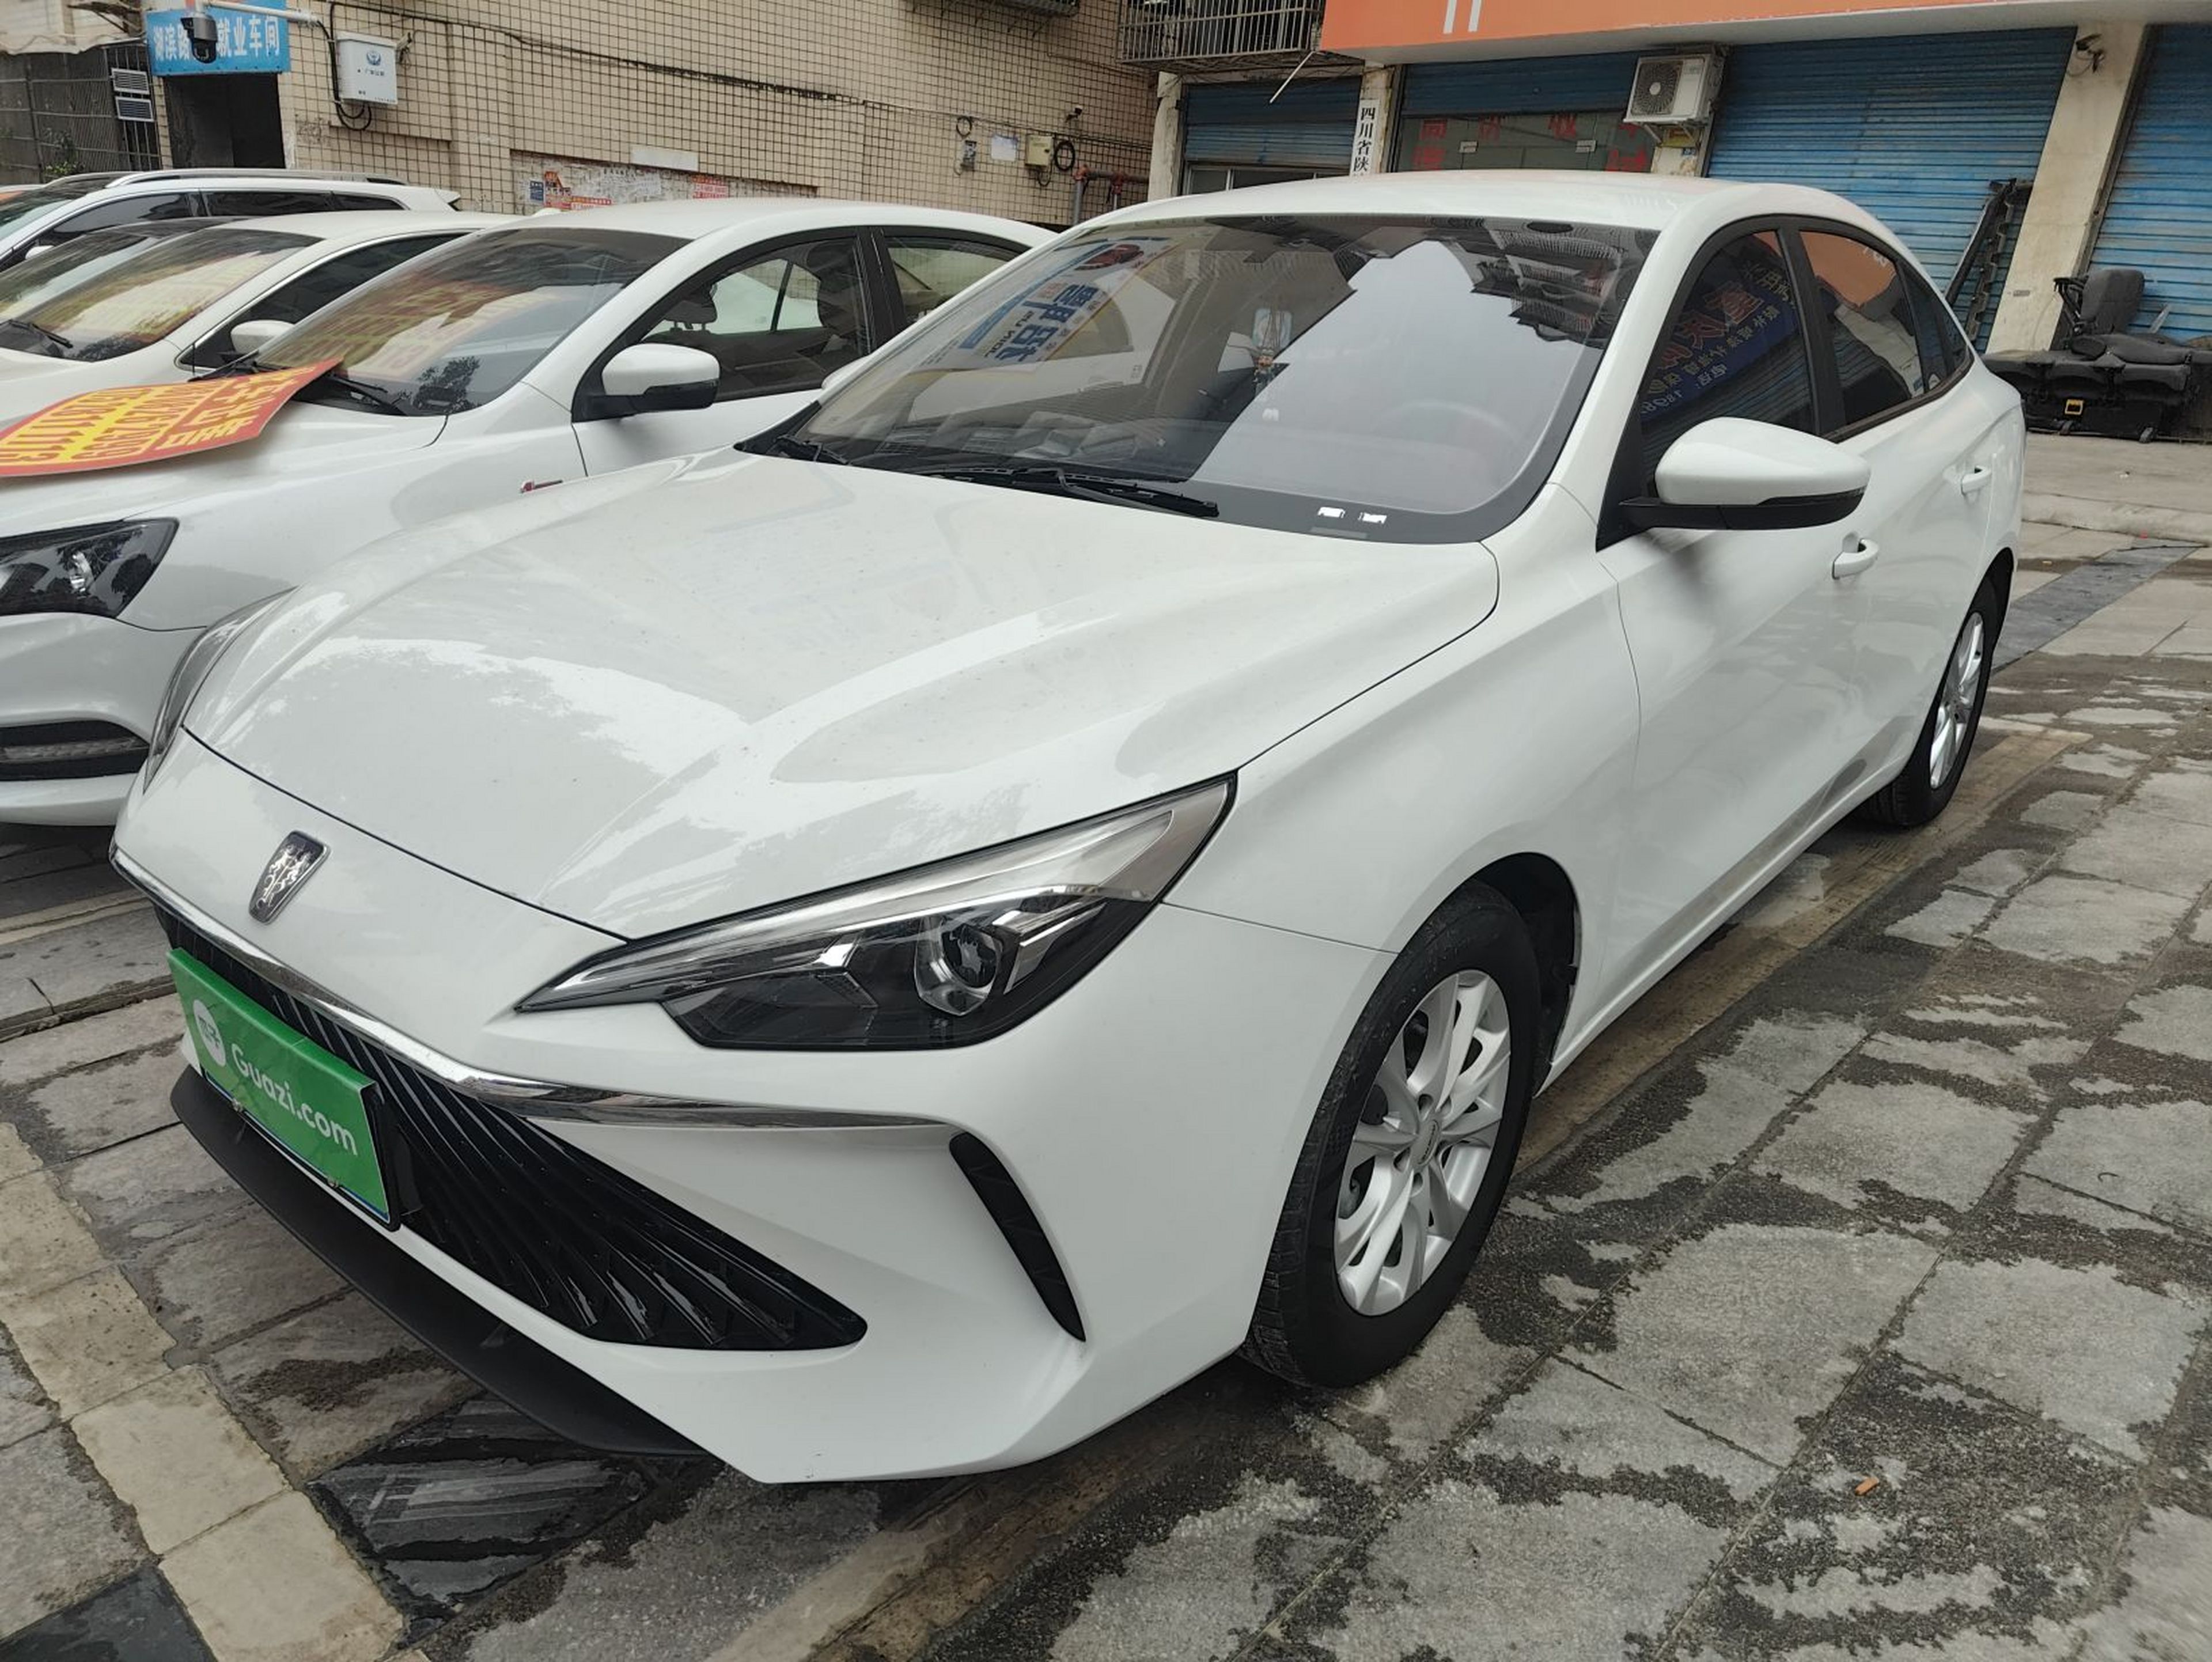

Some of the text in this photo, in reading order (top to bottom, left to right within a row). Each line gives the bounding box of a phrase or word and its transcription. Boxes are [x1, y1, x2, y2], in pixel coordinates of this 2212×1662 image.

[1353, 107, 1376, 176] 四川省陕
[232, 1043, 357, 1156] Guazi.com
